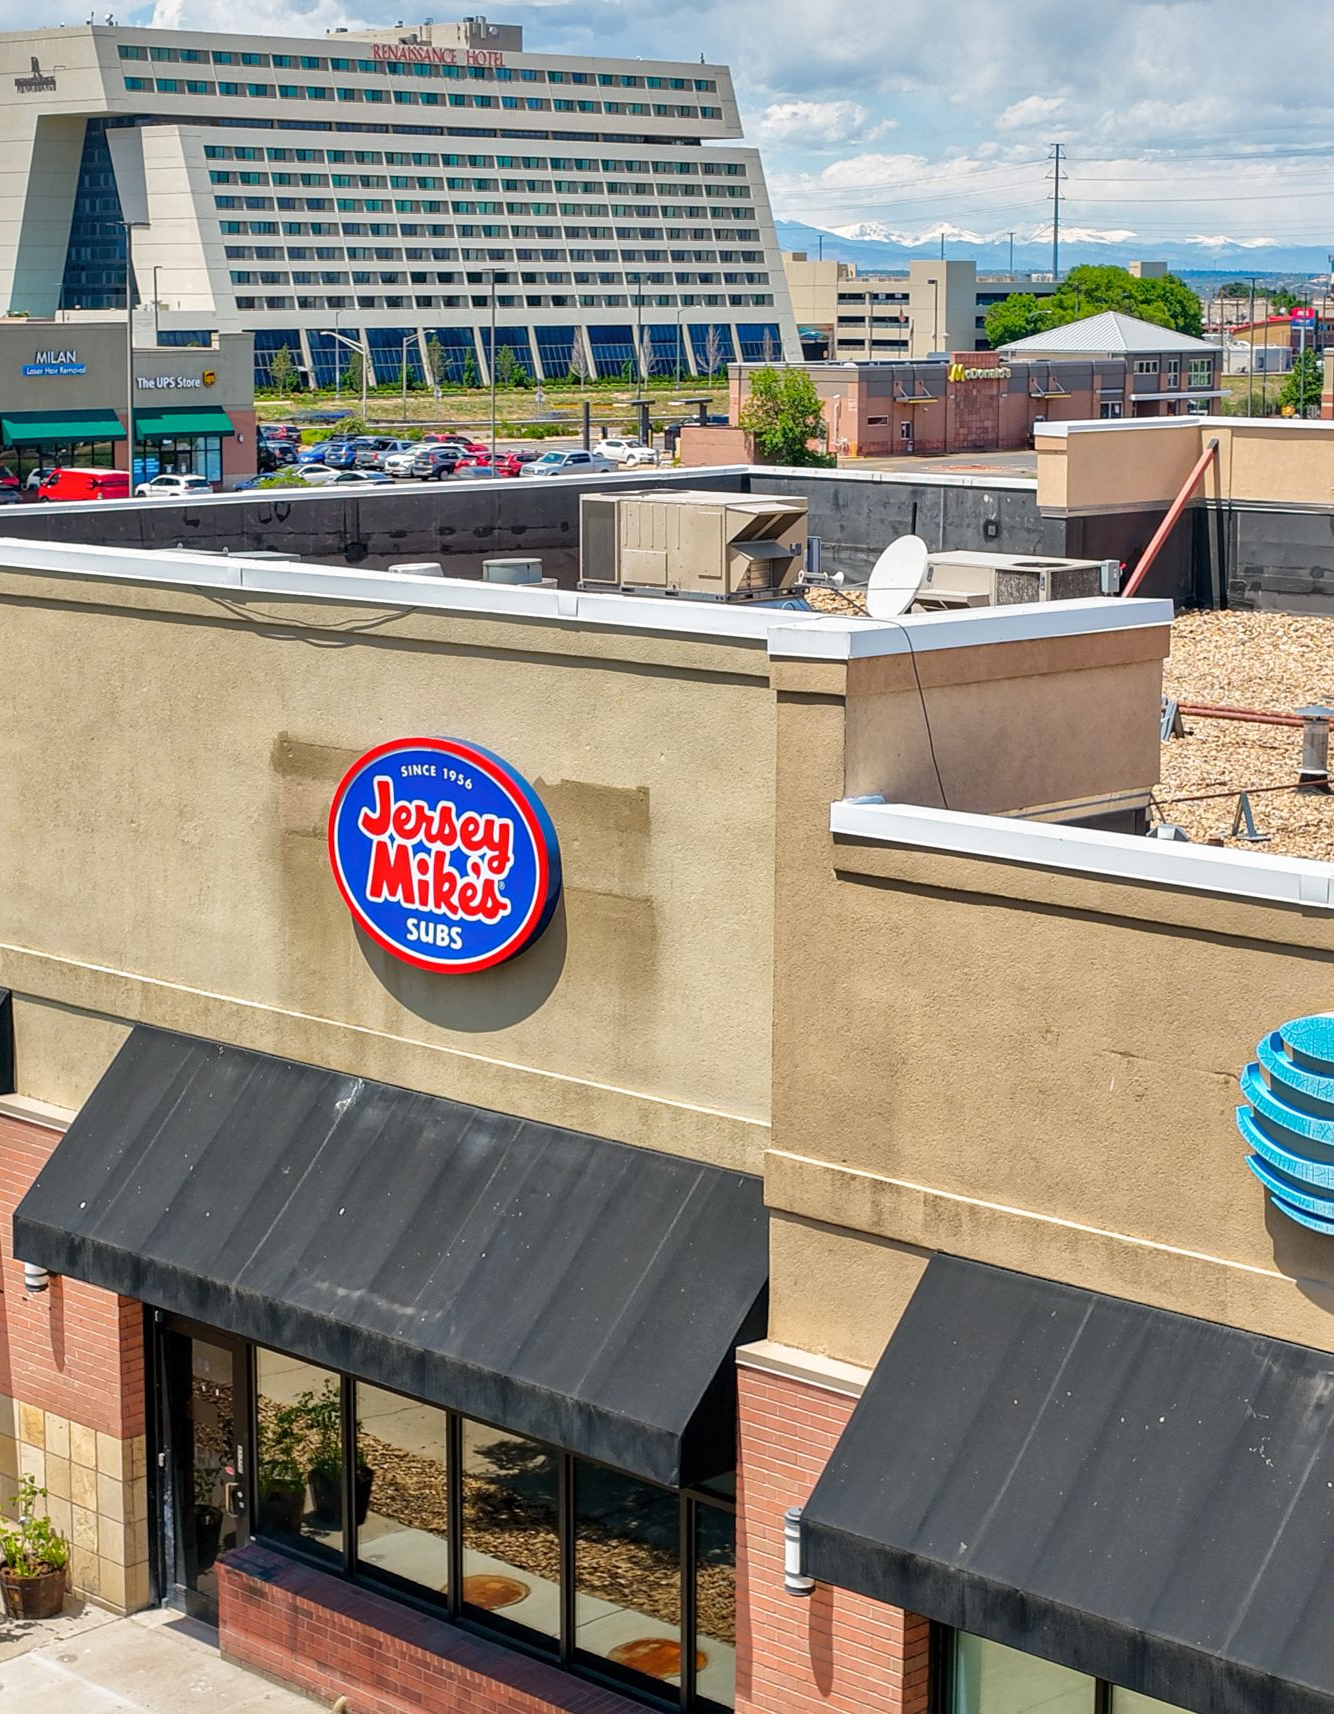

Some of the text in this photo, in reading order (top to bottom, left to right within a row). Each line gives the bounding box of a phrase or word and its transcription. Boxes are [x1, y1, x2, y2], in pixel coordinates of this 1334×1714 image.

[372, 43, 506, 67] RENAISSANCE HOTEL
[36, 351, 76, 364] MILAN
[59, 366, 86, 374] Removal
[137, 376, 201, 388] The UPS Store
[948, 363, 1011, 382] McDonald's
[400, 764, 473, 790] SINCE 1956
[359, 777, 513, 878] Jersey
[367, 838, 511, 923] Mike's
[406, 918, 463, 950] SUBS
